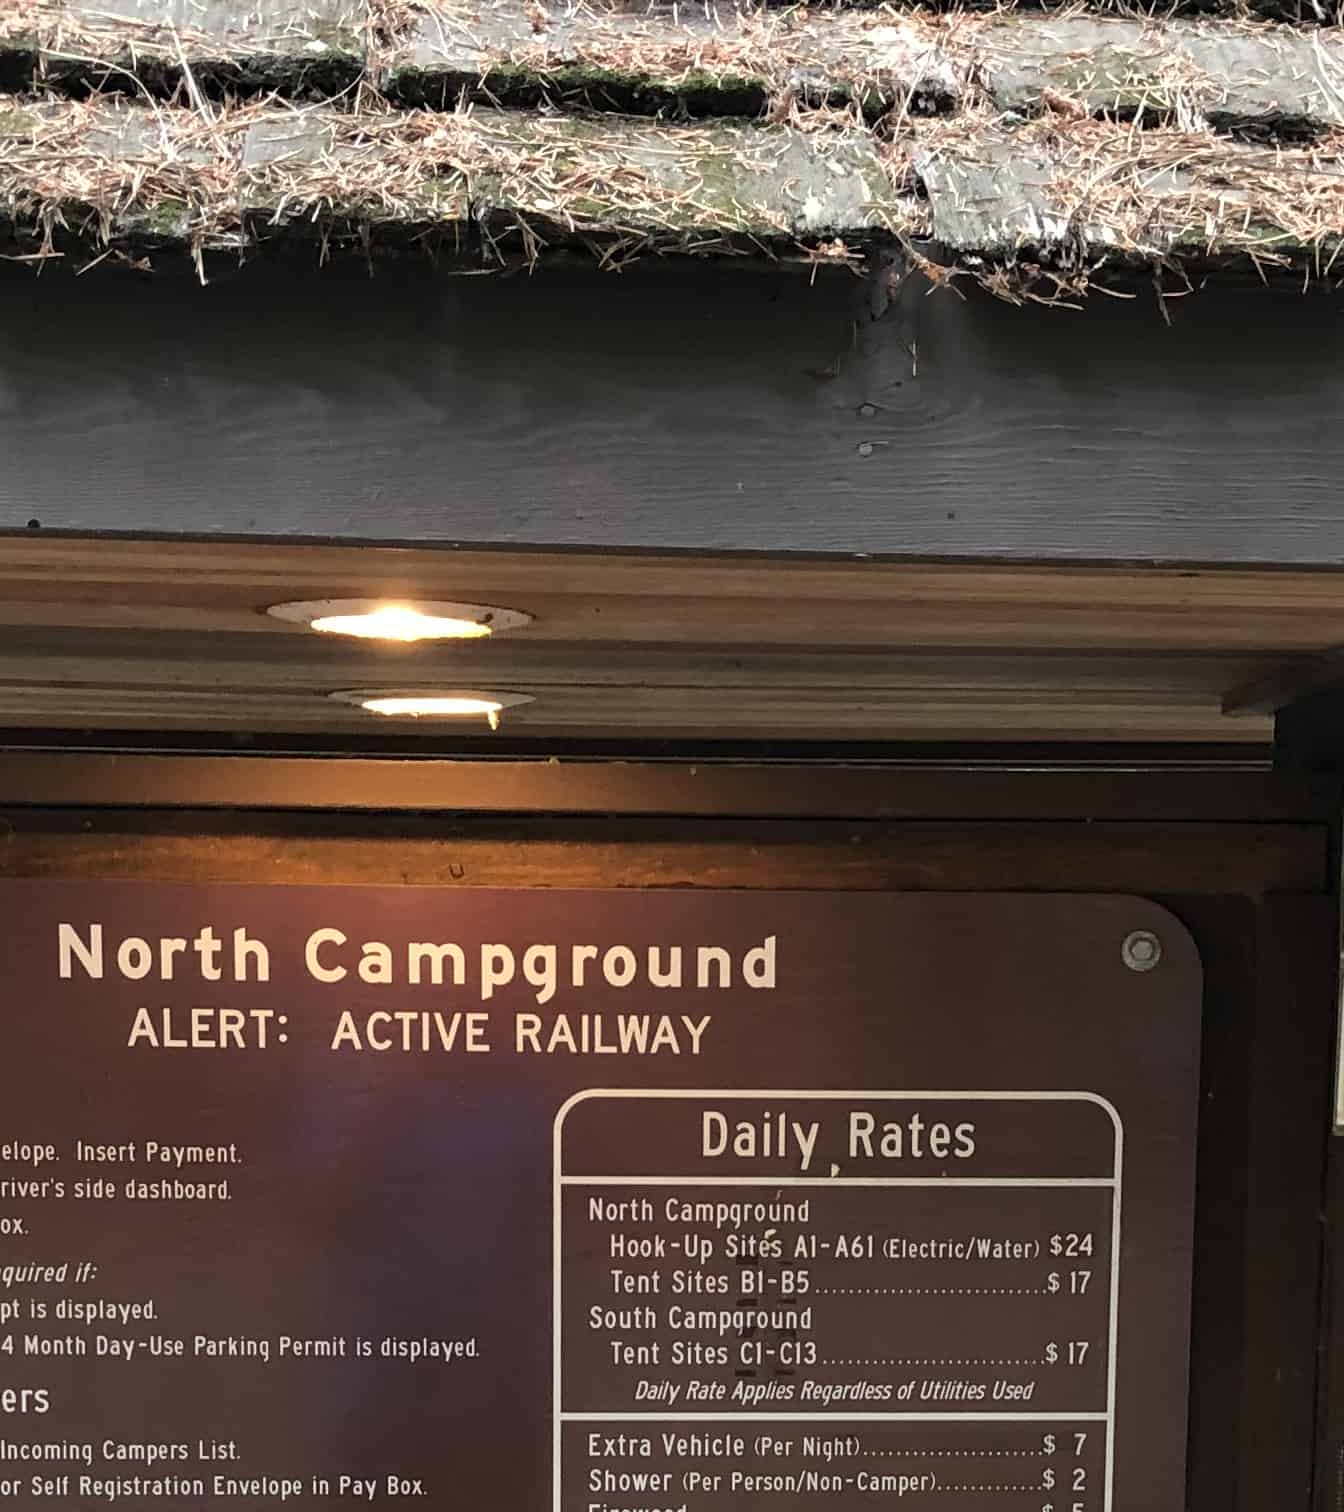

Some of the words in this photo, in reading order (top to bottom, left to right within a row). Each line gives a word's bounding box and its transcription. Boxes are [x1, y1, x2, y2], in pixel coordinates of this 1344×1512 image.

[58, 922, 274, 983] North
[305, 926, 776, 1005] Campground
[127, 1007, 288, 1049] ALERT:
[331, 1010, 490, 1052] ACTIVE
[516, 1013, 711, 1055] RAILWAY
[77, 1140, 136, 1162] Insert
[146, 1141, 242, 1168] Payment.
[702, 1111, 820, 1171] Daily
[848, 1111, 976, 1159] Rates
[589, 1197, 653, 1222] North
[665, 1197, 809, 1231] Campground
[610, 1233, 713, 1265] Hook-Up
[725, 1232, 782, 1258] Sites
[794, 1234, 873, 1259] A1-A61
[882, 1236, 1040, 1260] (Electric/Water)
[1049, 1233, 1093, 1257] $24
[74, 1262, 97, 1283] if:
[610, 1269, 661, 1294] Tent
[671, 1270, 729, 1294] Sites
[741, 1270, 809, 1294] B1-B5
[589, 1305, 656, 1329] South
[668, 1305, 812, 1337] Campground
[24, 1334, 86, 1355] Month
[96, 1335, 184, 1361] Day-Use
[194, 1335, 269, 1362] Parking
[279, 1336, 346, 1356] Permit
[356, 1336, 372, 1357] is
[380, 1336, 480, 1363] displayed.
[610, 1341, 660, 1365] Tent
[671, 1341, 728, 1365] Sites
[740, 1341, 817, 1365] C1-C13
[635, 1380, 681, 1405] Daily
[685, 1380, 726, 1400] Rate
[730, 1380, 795, 1406] Applies
[800, 1380, 893, 1406] Regardless
[897, 1380, 916, 1400] of
[920, 1380, 987, 1400] Utilities
[992, 1380, 1035, 1400] Used
[588, 1433, 651, 1457] Extra
[661, 1433, 745, 1457] Vehicle
[754, 1436, 793, 1457] (Per
[803, 1436, 860, 1462] Night)
[0, 1480, 22, 1496] or
[31, 1475, 69, 1496] Self
[79, 1475, 204, 1502] Registration
[213, 1475, 302, 1501] Envelope
[312, 1475, 329, 1495] in
[339, 1475, 377, 1501] Pay
[387, 1475, 427, 1495] Box.
[589, 1468, 673, 1492] Shower
[682, 1471, 722, 1491] (Per
[731, 1470, 936, 1497] Person/Non-Camper)
